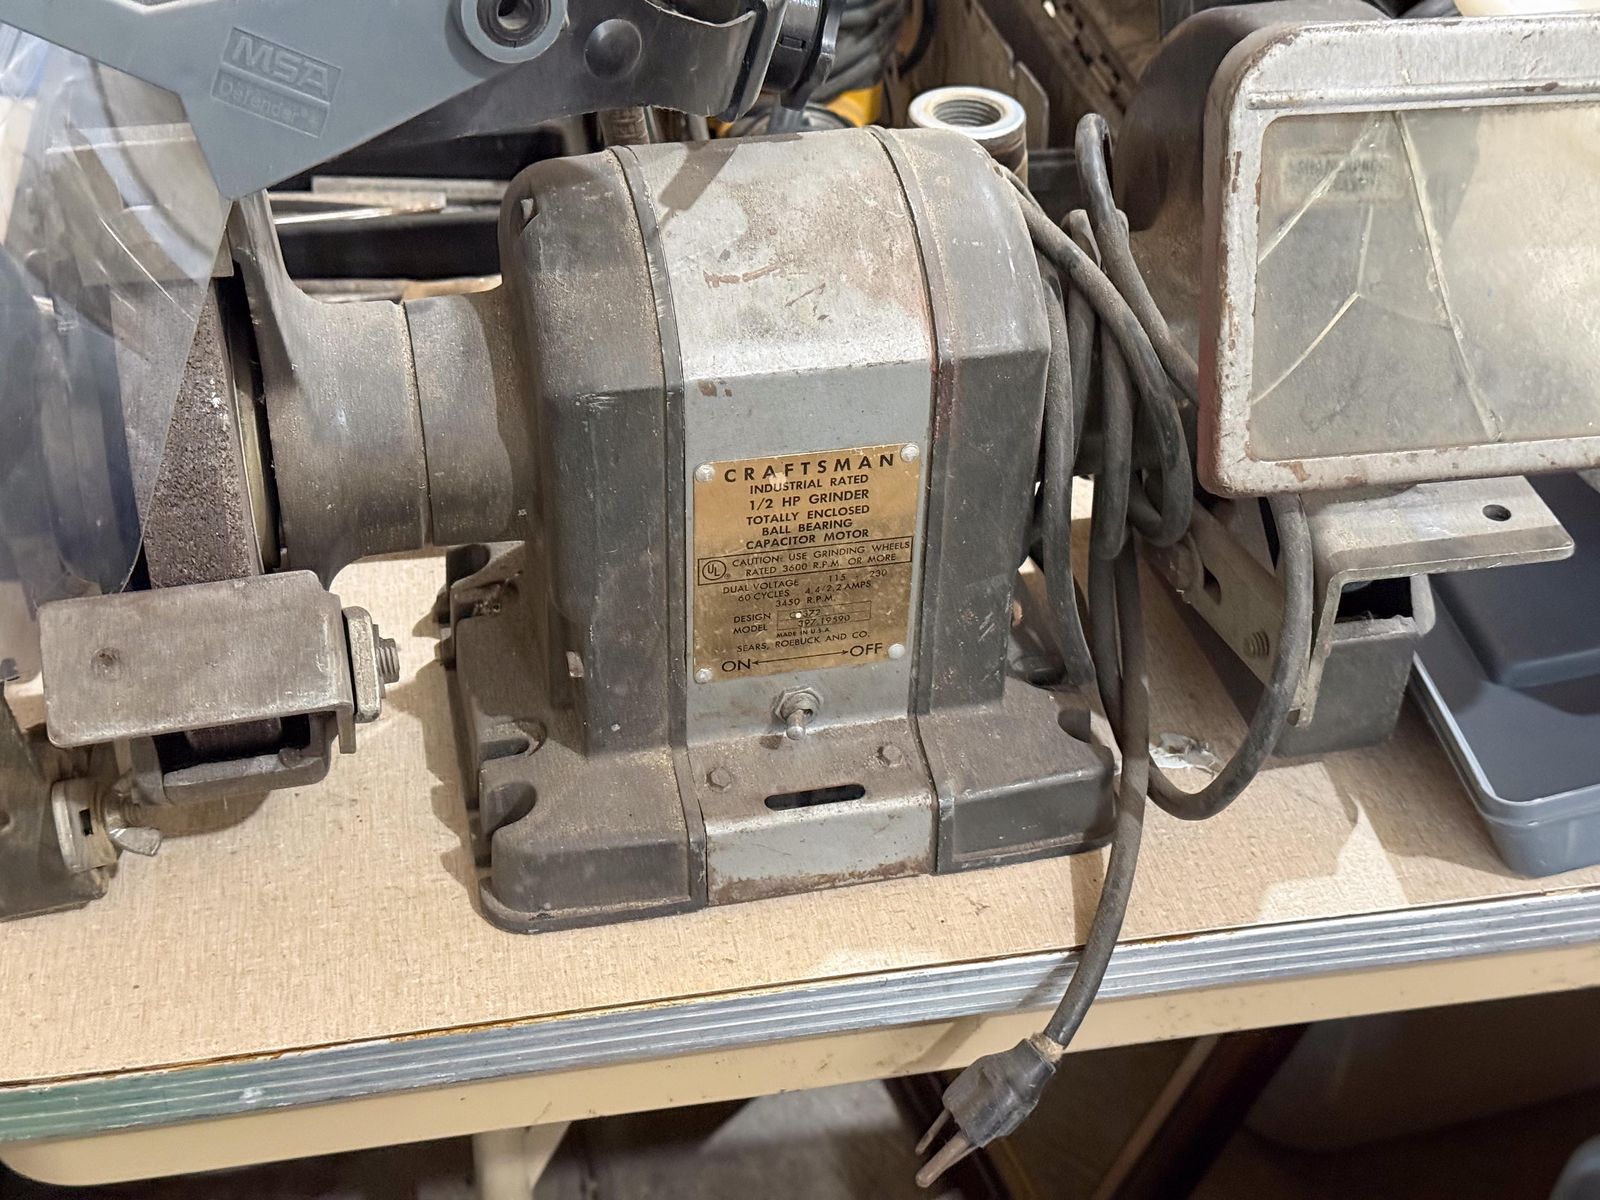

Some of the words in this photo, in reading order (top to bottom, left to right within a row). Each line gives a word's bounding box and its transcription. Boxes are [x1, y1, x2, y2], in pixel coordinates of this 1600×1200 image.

[231, 36, 329, 97] MSA
[724, 453, 894, 482] CRAFTSMAN
[750, 479, 823, 494] INDUSTRIAL
[830, 474, 869, 487] RATED
[750, 498, 774, 511] 1/2
[782, 496, 801, 508] HP
[809, 489, 869, 504] GRINDER
[746, 512, 799, 526] TOTALLY
[807, 504, 870, 519] ENCLOSED
[762, 526, 791, 536] BALL
[799, 519, 853, 532] BEARING
[746, 535, 816, 550] CAPACITOR
[824, 529, 869, 542] MOTOR
[788, 552, 808, 560] USE
[813, 546, 865, 559] GRINDING
[871, 541, 910, 552] WHEELS
[745, 566, 777, 577] RATED
[782, 563, 808, 572] 3600
[847, 557, 862, 566] OR
[867, 553, 896, 563] MORE
[723, 585, 749, 594] DUAL
[753, 579, 799, 590] VOLTAGE
[828, 574, 846, 582] 115
[870, 569, 888, 578] 230
[738, 594, 751, 602] 60
[753, 589, 790, 600] CYCLES
[844, 580, 872, 590] AMPS
[776, 598, 801, 608] 3450
[733, 612, 771, 623] DESIGN
[733, 624, 768, 634] MODEL
[776, 631, 797, 639] MADE
[737, 643, 769, 653] SEARS,
[775, 636, 821, 648] ROEBUCK
[824, 633, 847, 642] AND
[852, 630, 870, 639] CO.
[721, 658, 751, 672] ON
[849, 642, 884, 657] OFF
